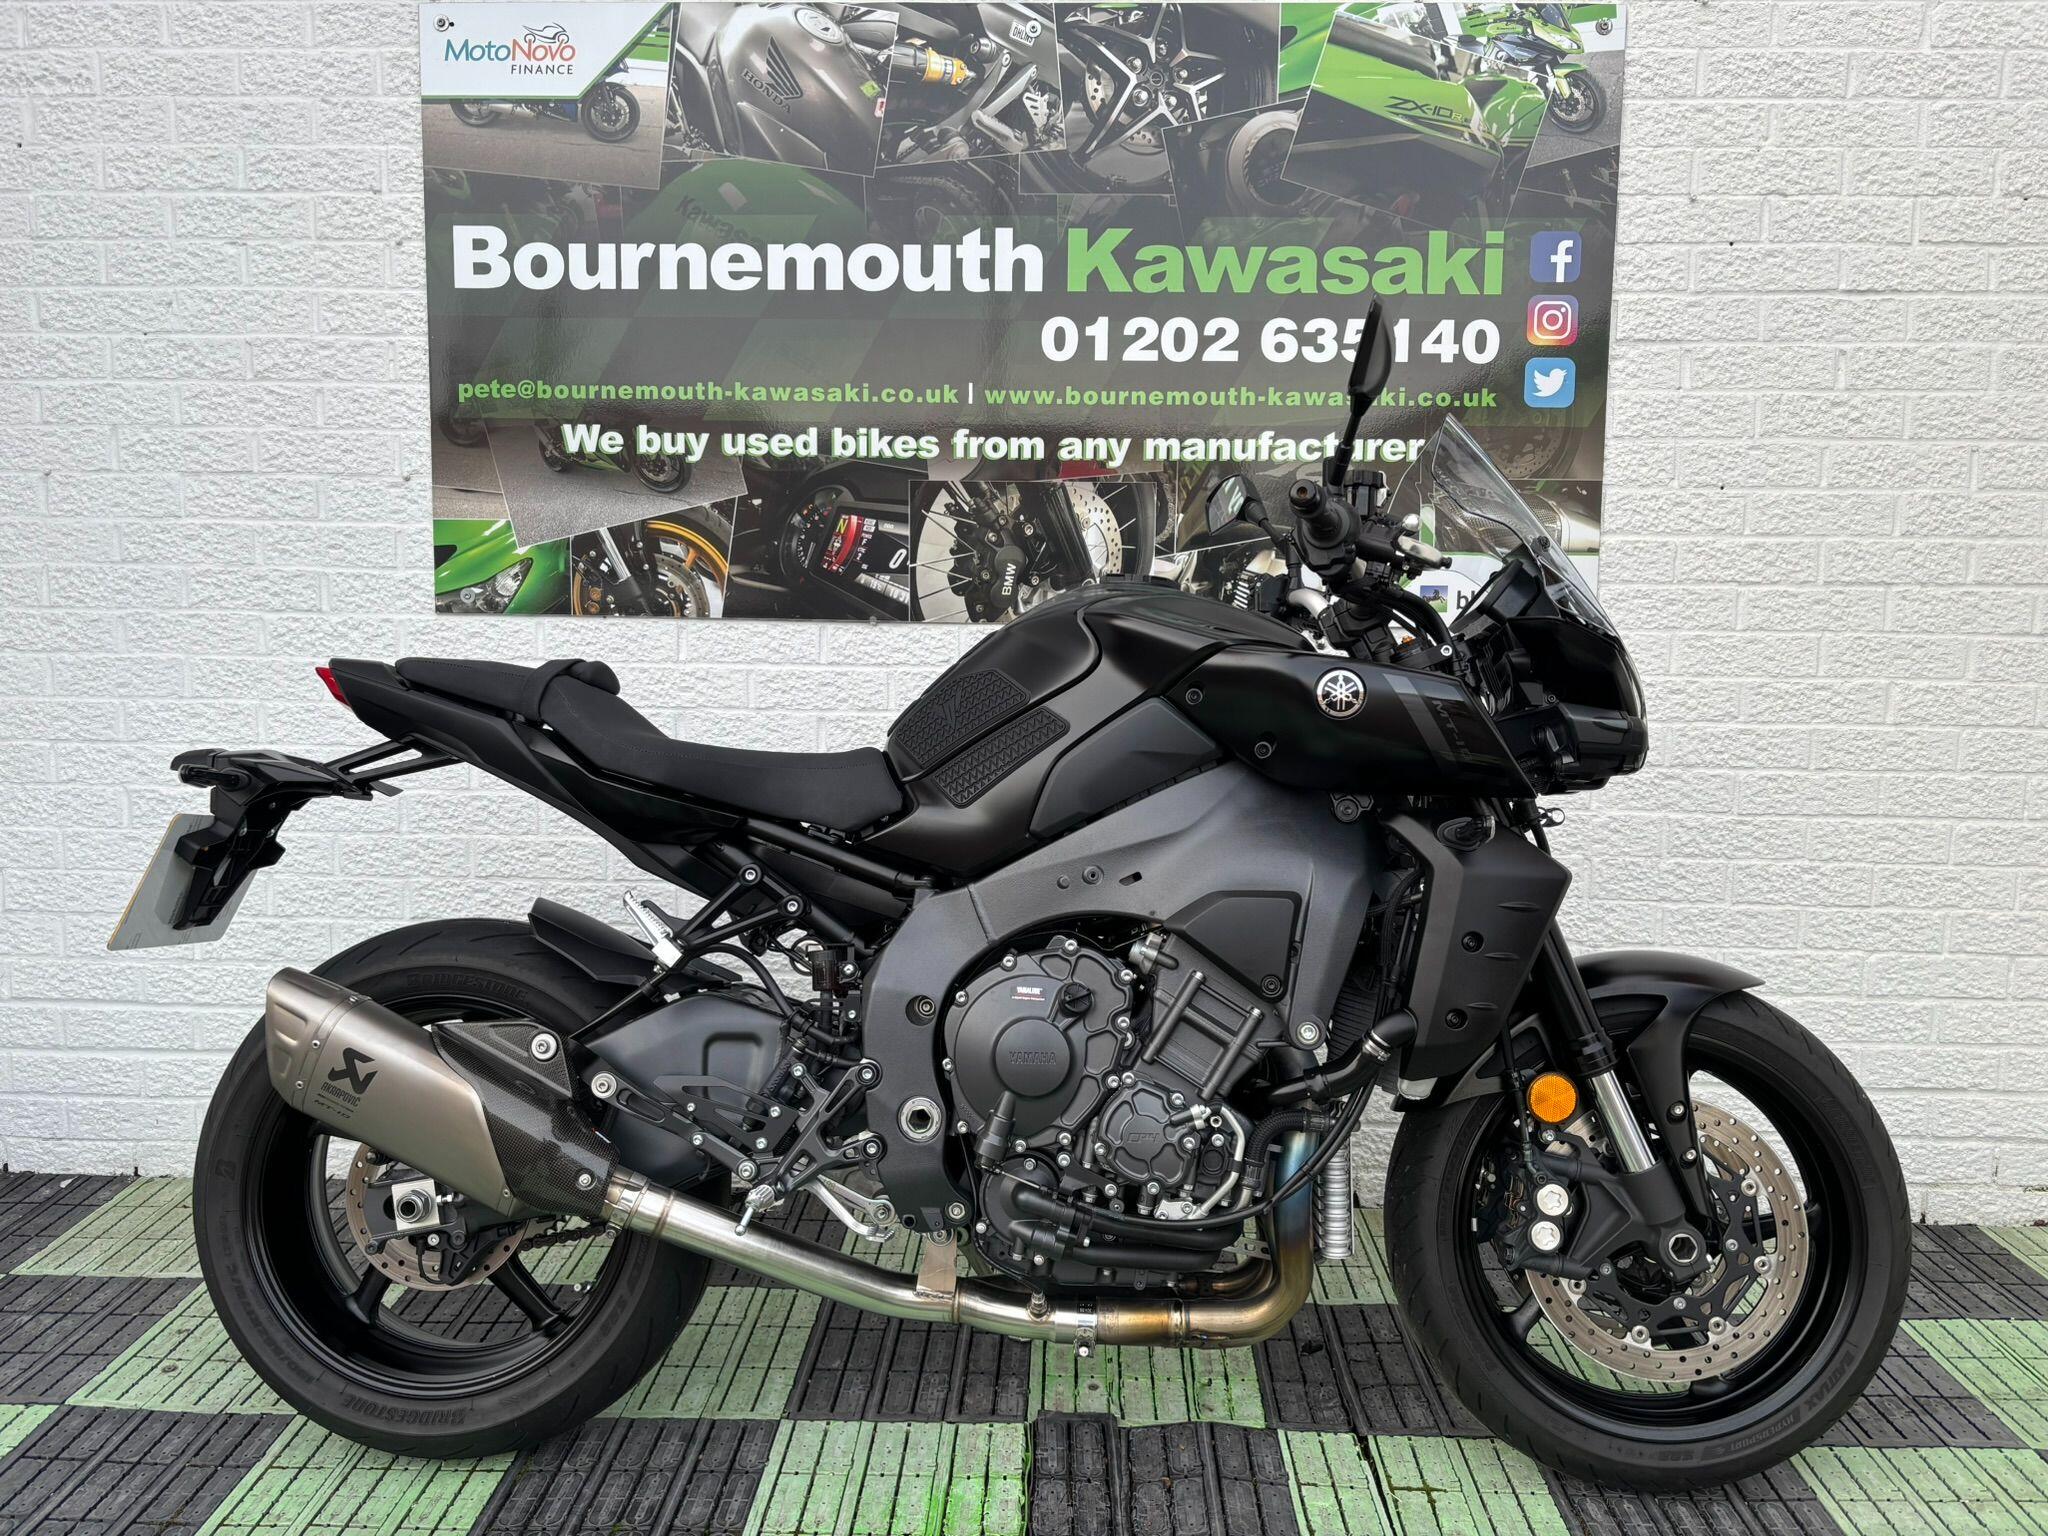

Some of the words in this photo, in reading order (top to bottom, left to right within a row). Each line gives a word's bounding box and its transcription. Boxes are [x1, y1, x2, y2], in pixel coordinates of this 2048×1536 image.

[444, 38, 577, 62] MotoNovo
[510, 64, 574, 75] FINANCE
[743, 69, 791, 113] HONDA
[452, 224, 1044, 293] Bournemouth
[1066, 227, 1504, 295] Kawasaki
[1041, 316, 1240, 362] 01202
[1260, 317, 1500, 364] 635140
[458, 379, 960, 403] pete@bournemouth-kawasaki.co.uk
[984, 385, 1497, 408] www.bournemouth-kawaki.co.uk
[561, 423, 625, 455] We
[636, 424, 710, 464] buy
[720, 427, 819, 460] used
[831, 427, 941, 461] bikes
[952, 429, 1046, 461] from
[1057, 436, 1132, 469] any
[1001, 563, 1017, 596] BMW
[1008, 1051, 1058, 1065] YAMAHA
